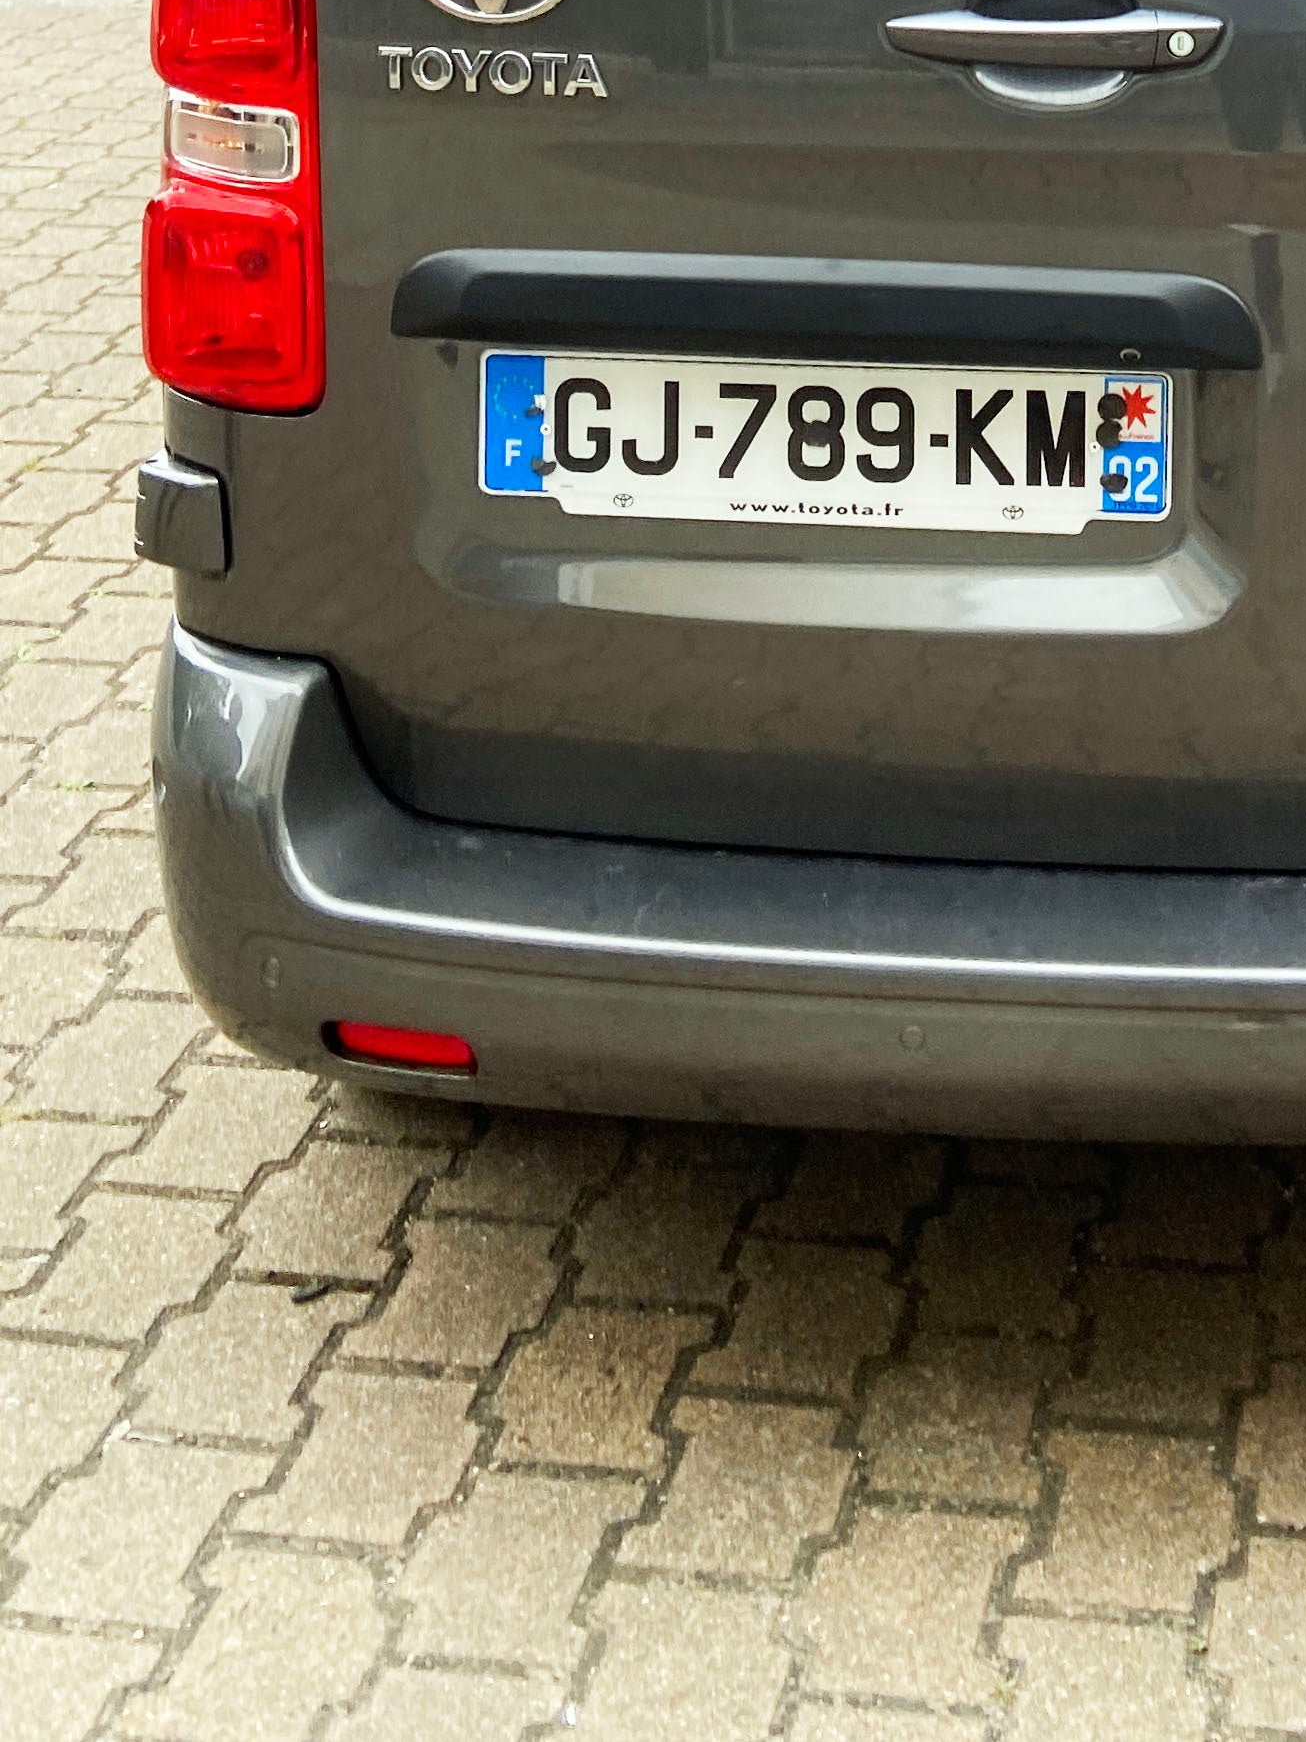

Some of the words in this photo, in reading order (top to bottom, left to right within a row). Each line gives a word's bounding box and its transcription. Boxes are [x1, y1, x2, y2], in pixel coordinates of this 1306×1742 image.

[378, 44, 609, 99] TOYOTA
[504, 439, 523, 468] F
[552, 376, 1087, 489] GJ-789-KM
[729, 501, 904, 517] www.toyota.fr
